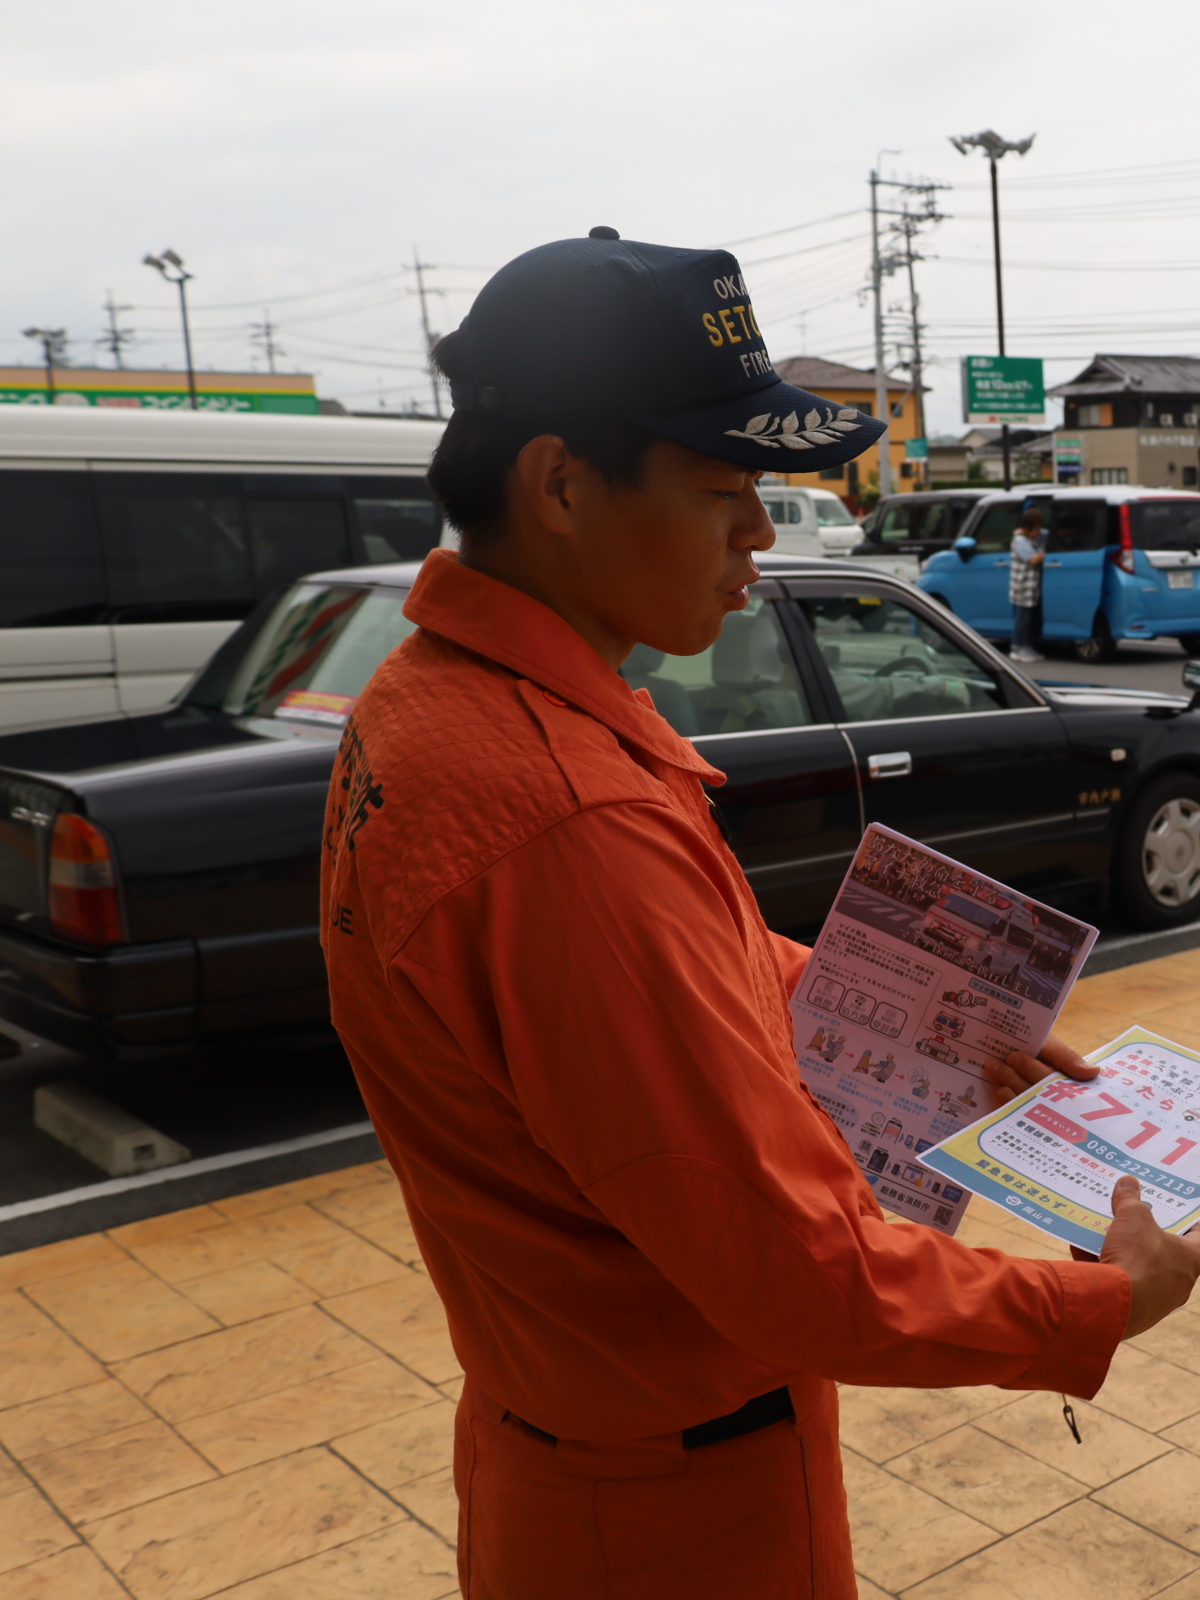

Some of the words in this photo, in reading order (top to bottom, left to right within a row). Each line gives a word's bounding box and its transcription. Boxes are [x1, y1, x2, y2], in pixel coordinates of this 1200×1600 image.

[860, 850, 945, 900] マイナ救急
[867, 832, 999, 906] あなたの命を守る
[812, 994, 833, 1009] 病歴
[840, 1005, 868, 1024] 処方歴
[871, 1018, 899, 1037] 受診歴
[1094, 1066, 1180, 1111] 迷ったら
[993, 1134, 1112, 1198] 医療機関の案内など経験豊富な相談員
[1083, 1139, 1198, 1196] 086-222-7119
[879, 1185, 930, 1212] 総務省消防庁
[1020, 1204, 1055, 1225] 岡山県
